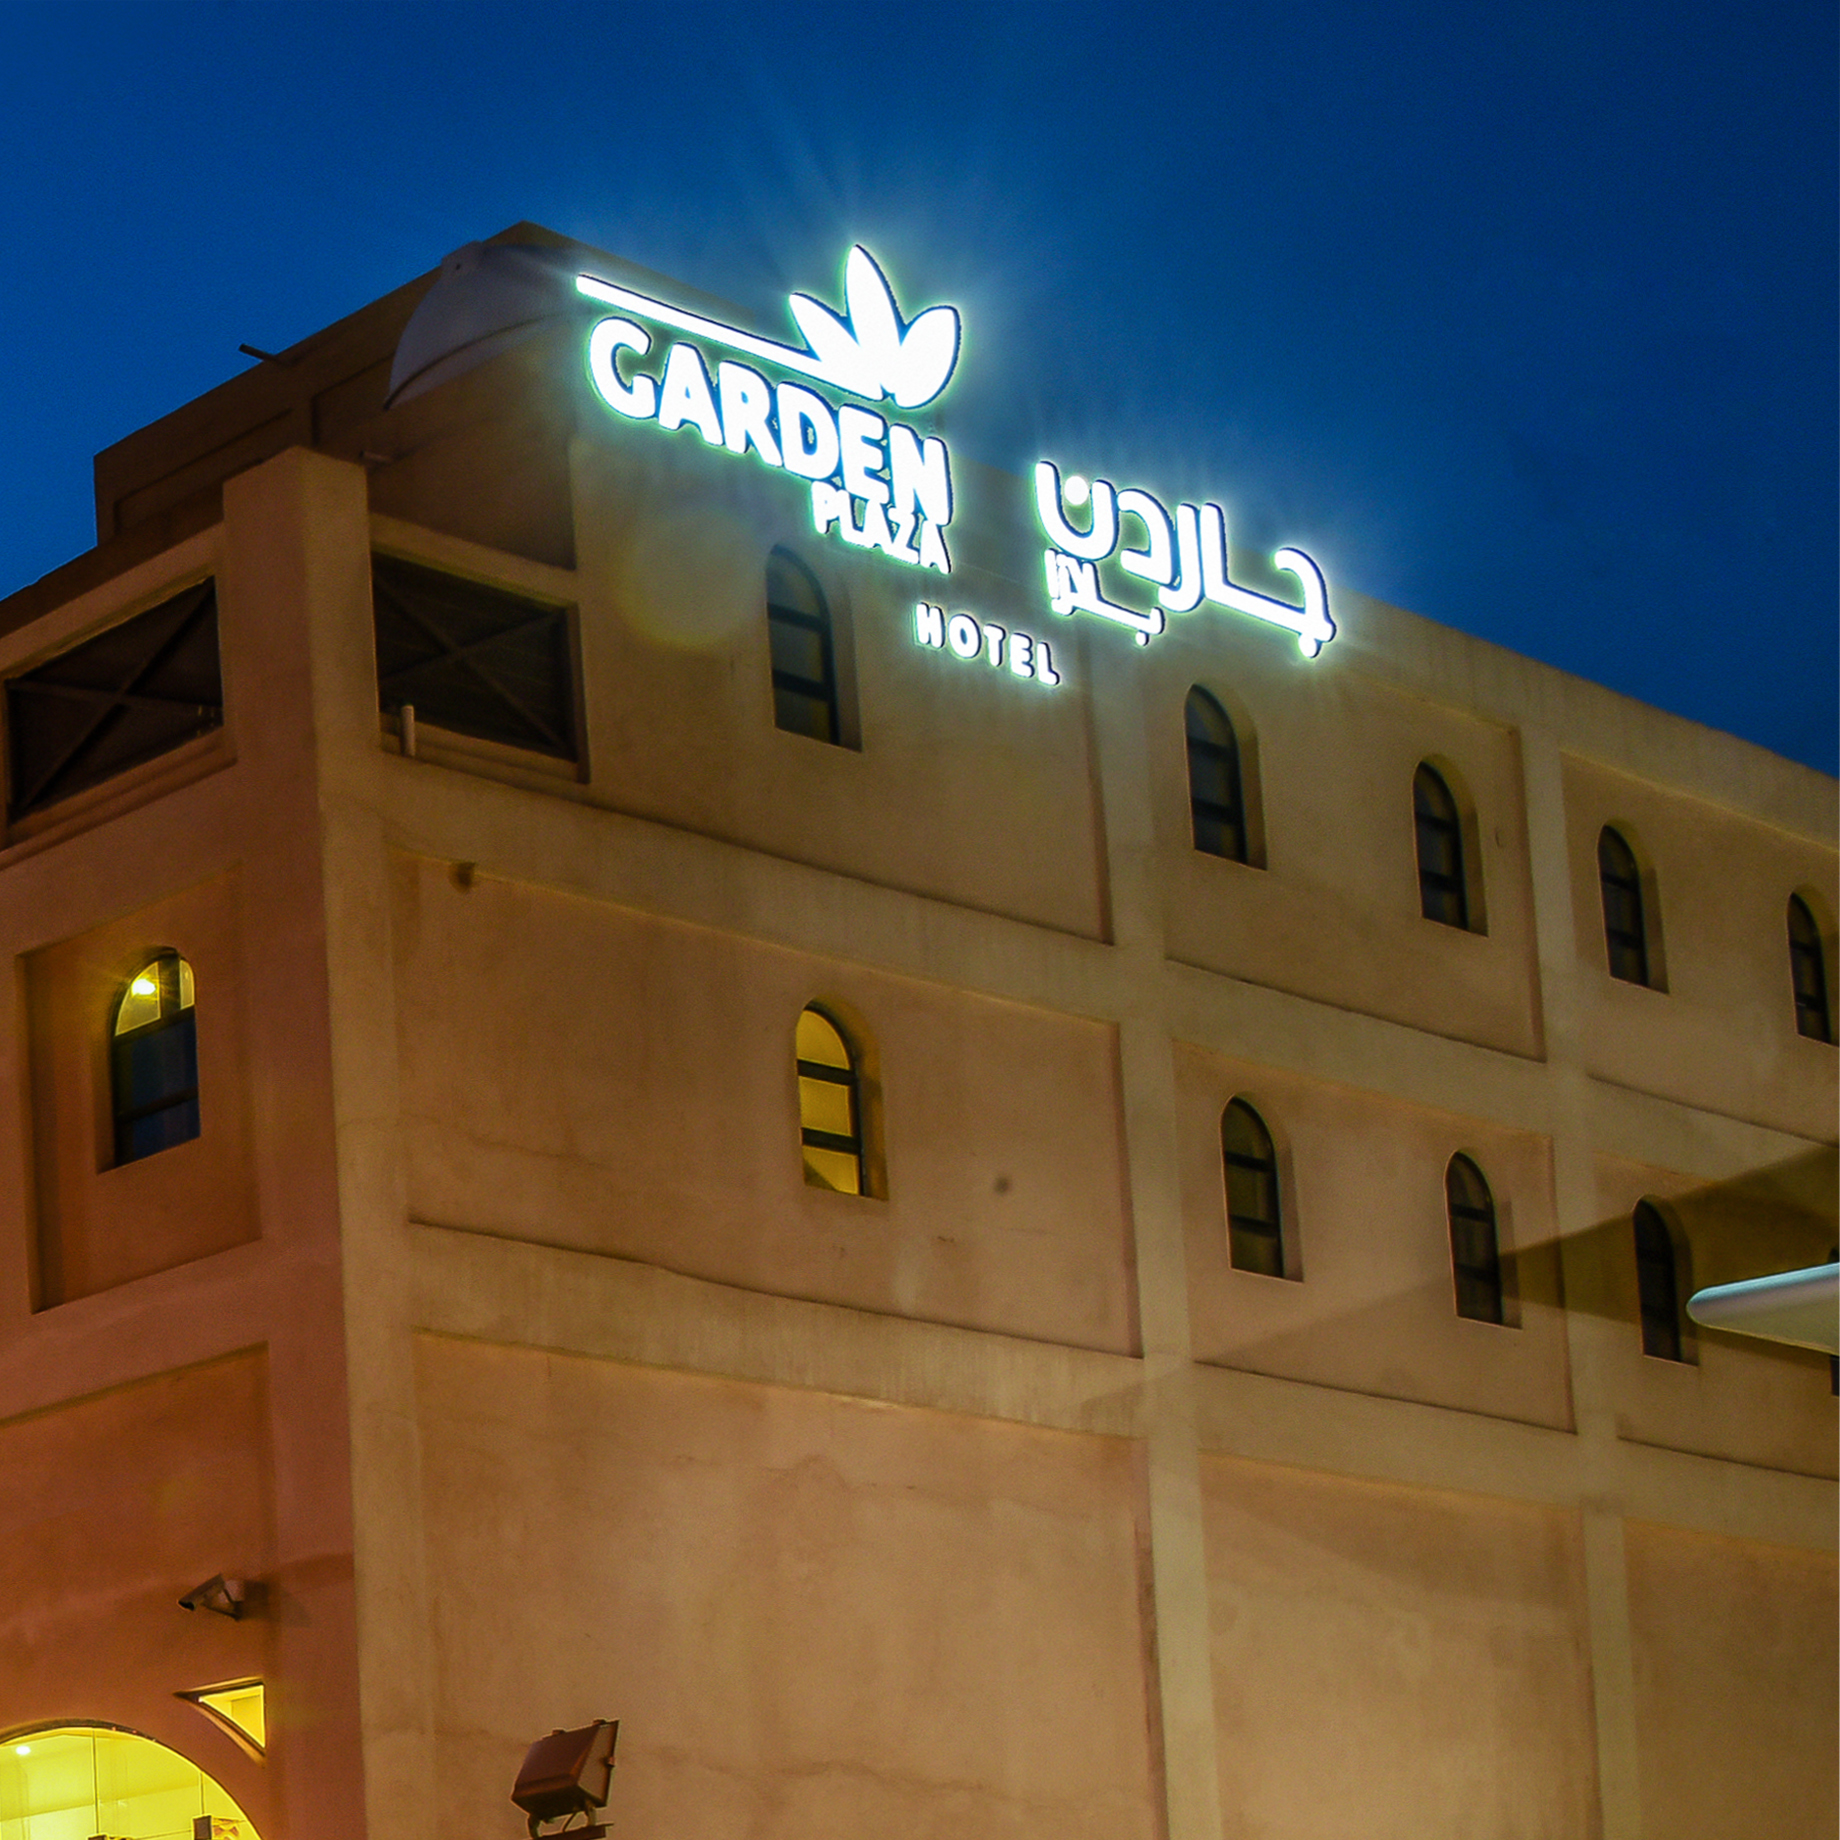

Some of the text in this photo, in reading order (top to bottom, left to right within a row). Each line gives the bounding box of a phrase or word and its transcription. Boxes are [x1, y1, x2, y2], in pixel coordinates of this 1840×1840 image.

[588, 317, 952, 527] GARDEN
[811, 480, 951, 574] PLAZA
[1034, 461, 1336, 658] جاردن
[916, 602, 1061, 686] HOTEL
